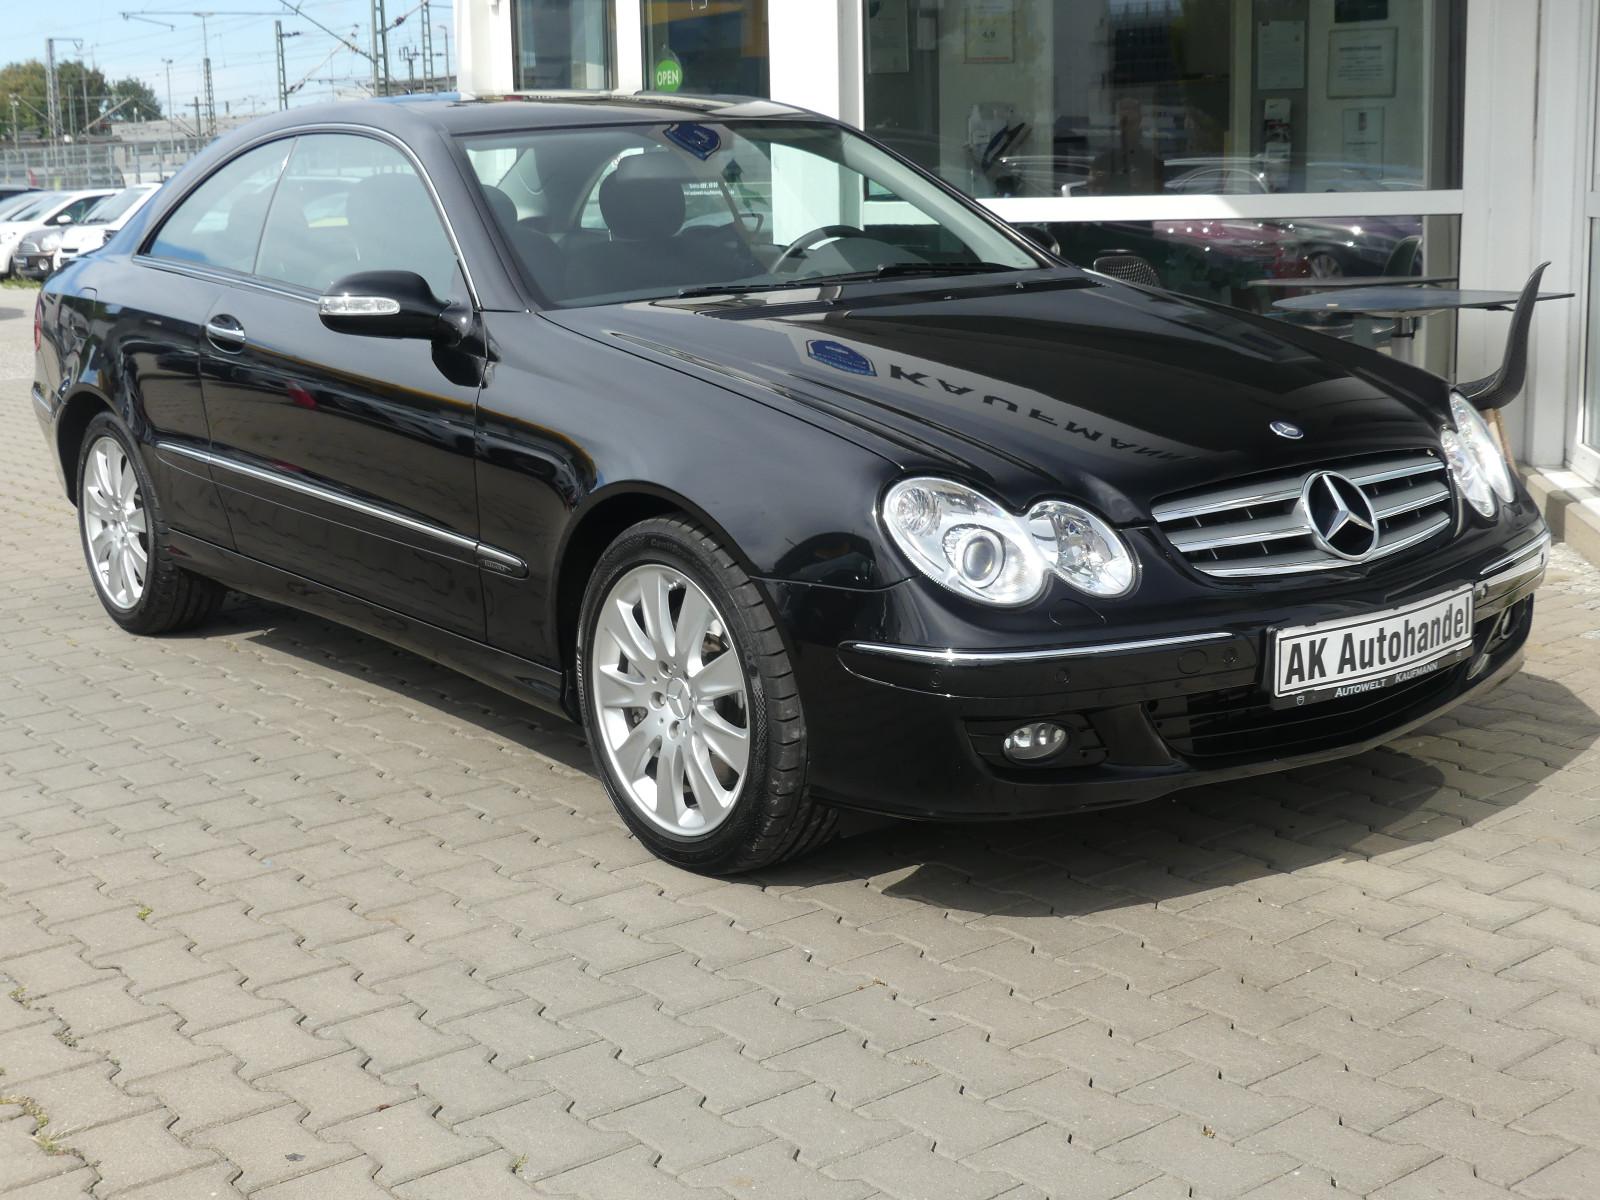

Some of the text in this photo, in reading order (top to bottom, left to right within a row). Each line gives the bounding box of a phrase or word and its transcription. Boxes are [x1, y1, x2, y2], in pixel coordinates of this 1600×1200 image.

[656, 70, 679, 87] OPEN
[1285, 597, 1469, 685] AK Autohandel
[1334, 661, 1439, 698] AUTOWELT KAUFMANN
